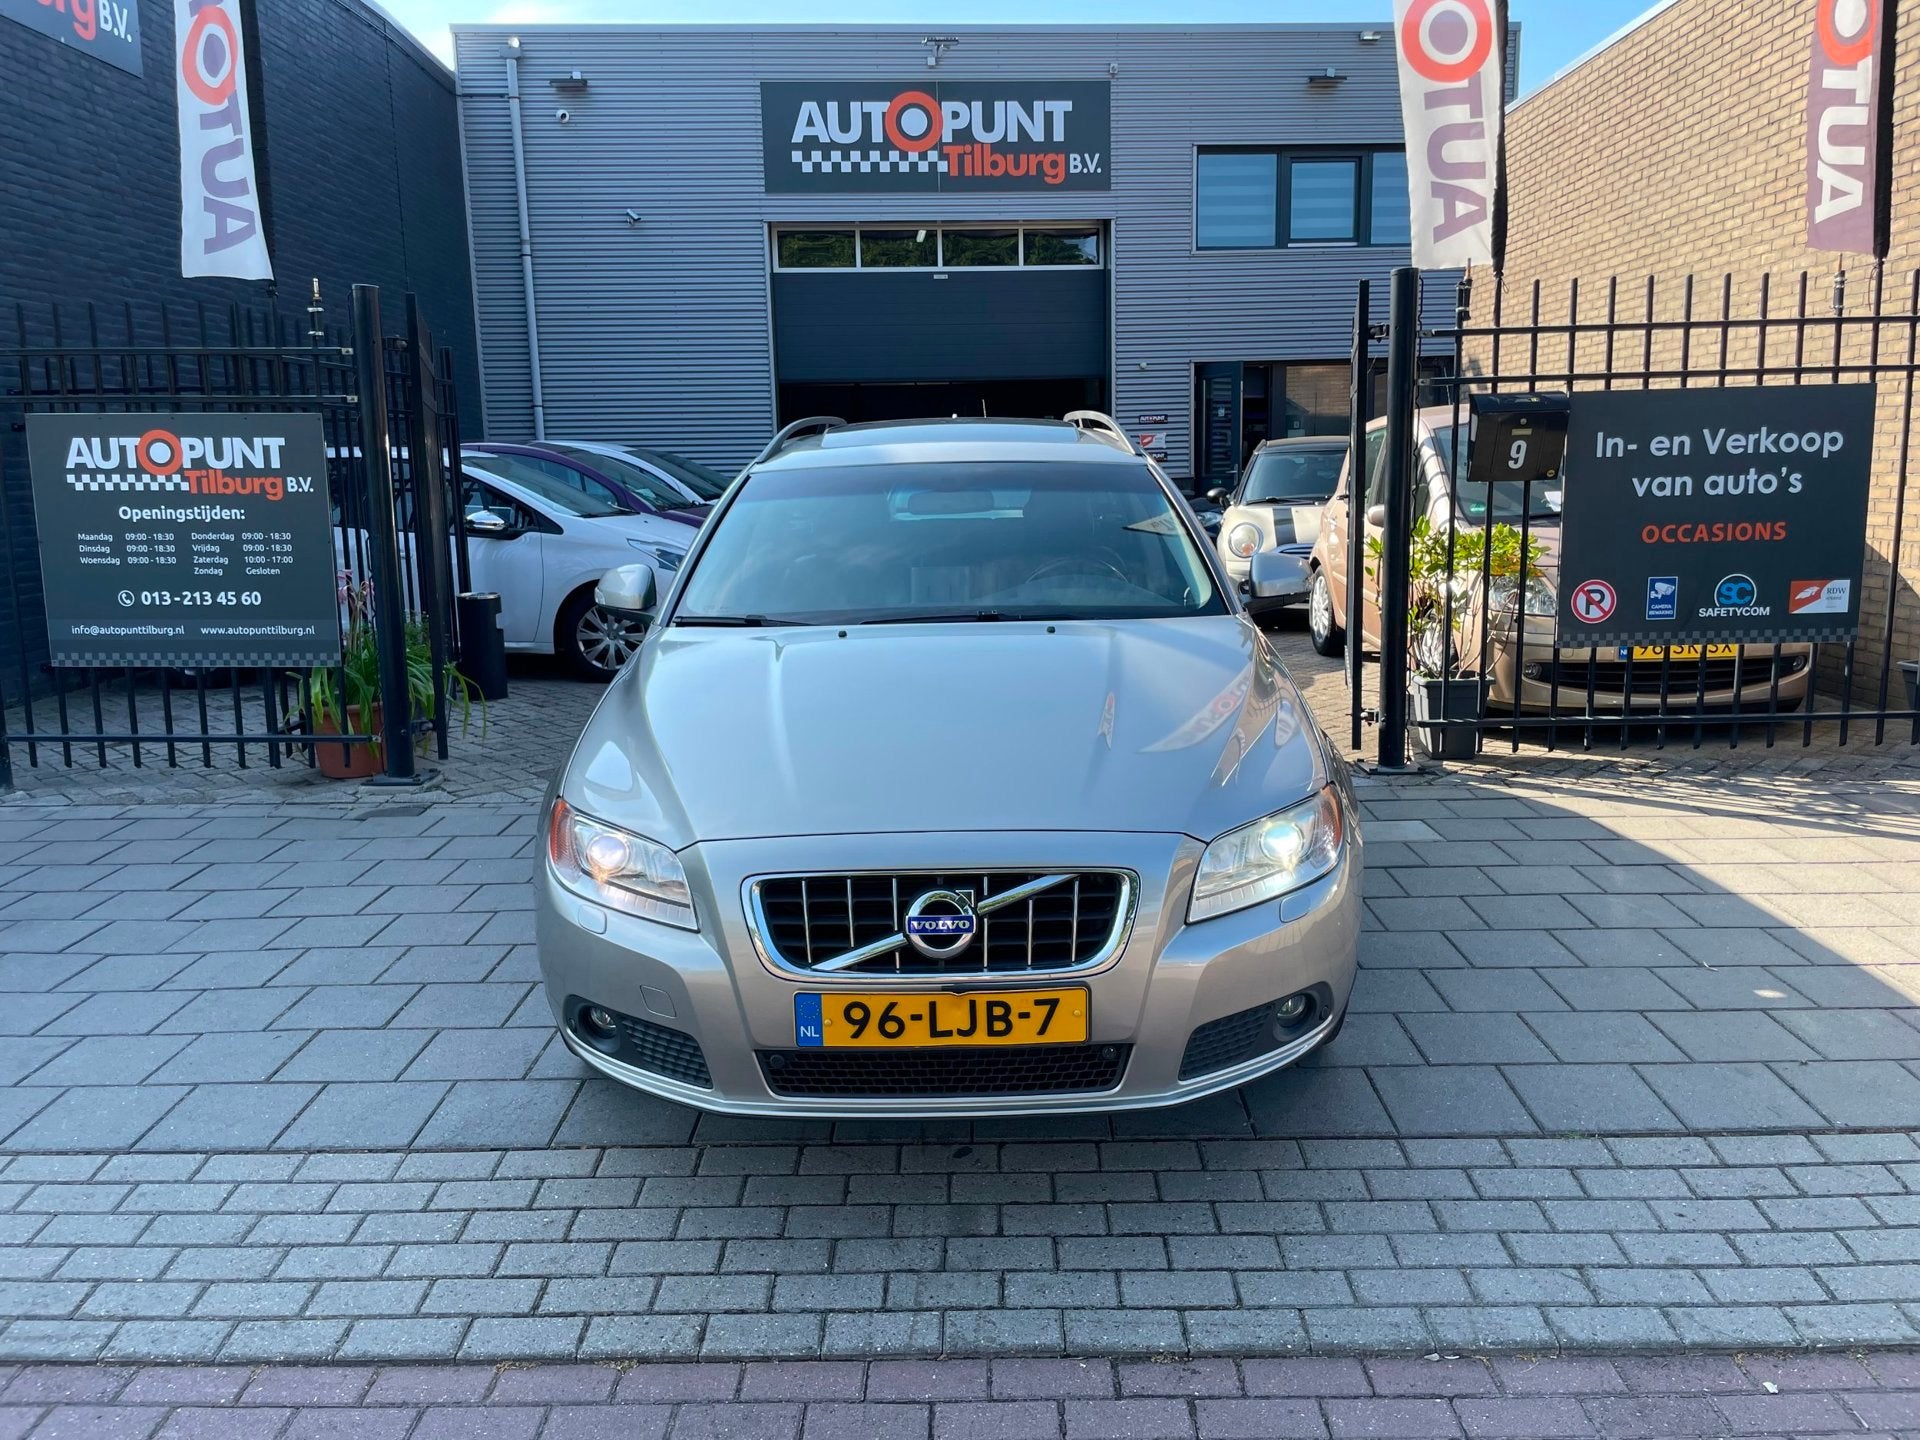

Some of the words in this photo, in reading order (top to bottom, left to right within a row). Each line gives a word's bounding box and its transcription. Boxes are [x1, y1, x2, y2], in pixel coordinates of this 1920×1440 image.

[791, 91, 1073, 153] AUTOPUNT
[943, 144, 1066, 184] Tilburg
[1070, 153, 1102, 174] B.V.
[1595, 431, 1637, 458] In-
[1650, 433, 1690, 457] en
[1702, 427, 1844, 458] Verkoop
[66, 429, 285, 476] AUTOPUNT
[1508, 440, 1527, 469] 9
[184, 470, 283, 500] Tilburg
[287, 476, 314, 493] B.V.
[1632, 475, 1692, 498] van
[1704, 466, 1803, 496] auto's
[118, 505, 246, 523] Openingstijden:
[77, 533, 113, 542] Maandag
[125, 533, 147, 541] 09:00
[153, 533, 175, 541] 18:30
[191, 532, 235, 541] Donderdag
[242, 532, 264, 540] 09:00
[270, 532, 291, 540] 18:30
[1641, 520, 1787, 544] OCCASIONS
[79, 545, 110, 553] Dinsdag
[192, 544, 220, 553] Vrijdag
[243, 544, 264, 552] 09:00
[271, 544, 292, 552] 18:30
[80, 557, 120, 565] Woensdag
[193, 556, 229, 565] Zaterdag
[194, 567, 223, 576] Zondag
[246, 567, 280, 575] Gesloten
[1826, 587, 1846, 595] RDW
[216, 591, 237, 605] 45
[241, 591, 262, 605] 60
[1698, 606, 1770, 618] SAFETYCOM
[71, 624, 185, 636] info@autopunttilburg.nl
[200, 625, 315, 637] www.autopunttilburg.nl
[911, 919, 970, 931] VOLVO
[800, 1025, 820, 1038] NL
[843, 998, 1060, 1040] 96-LJB-7
